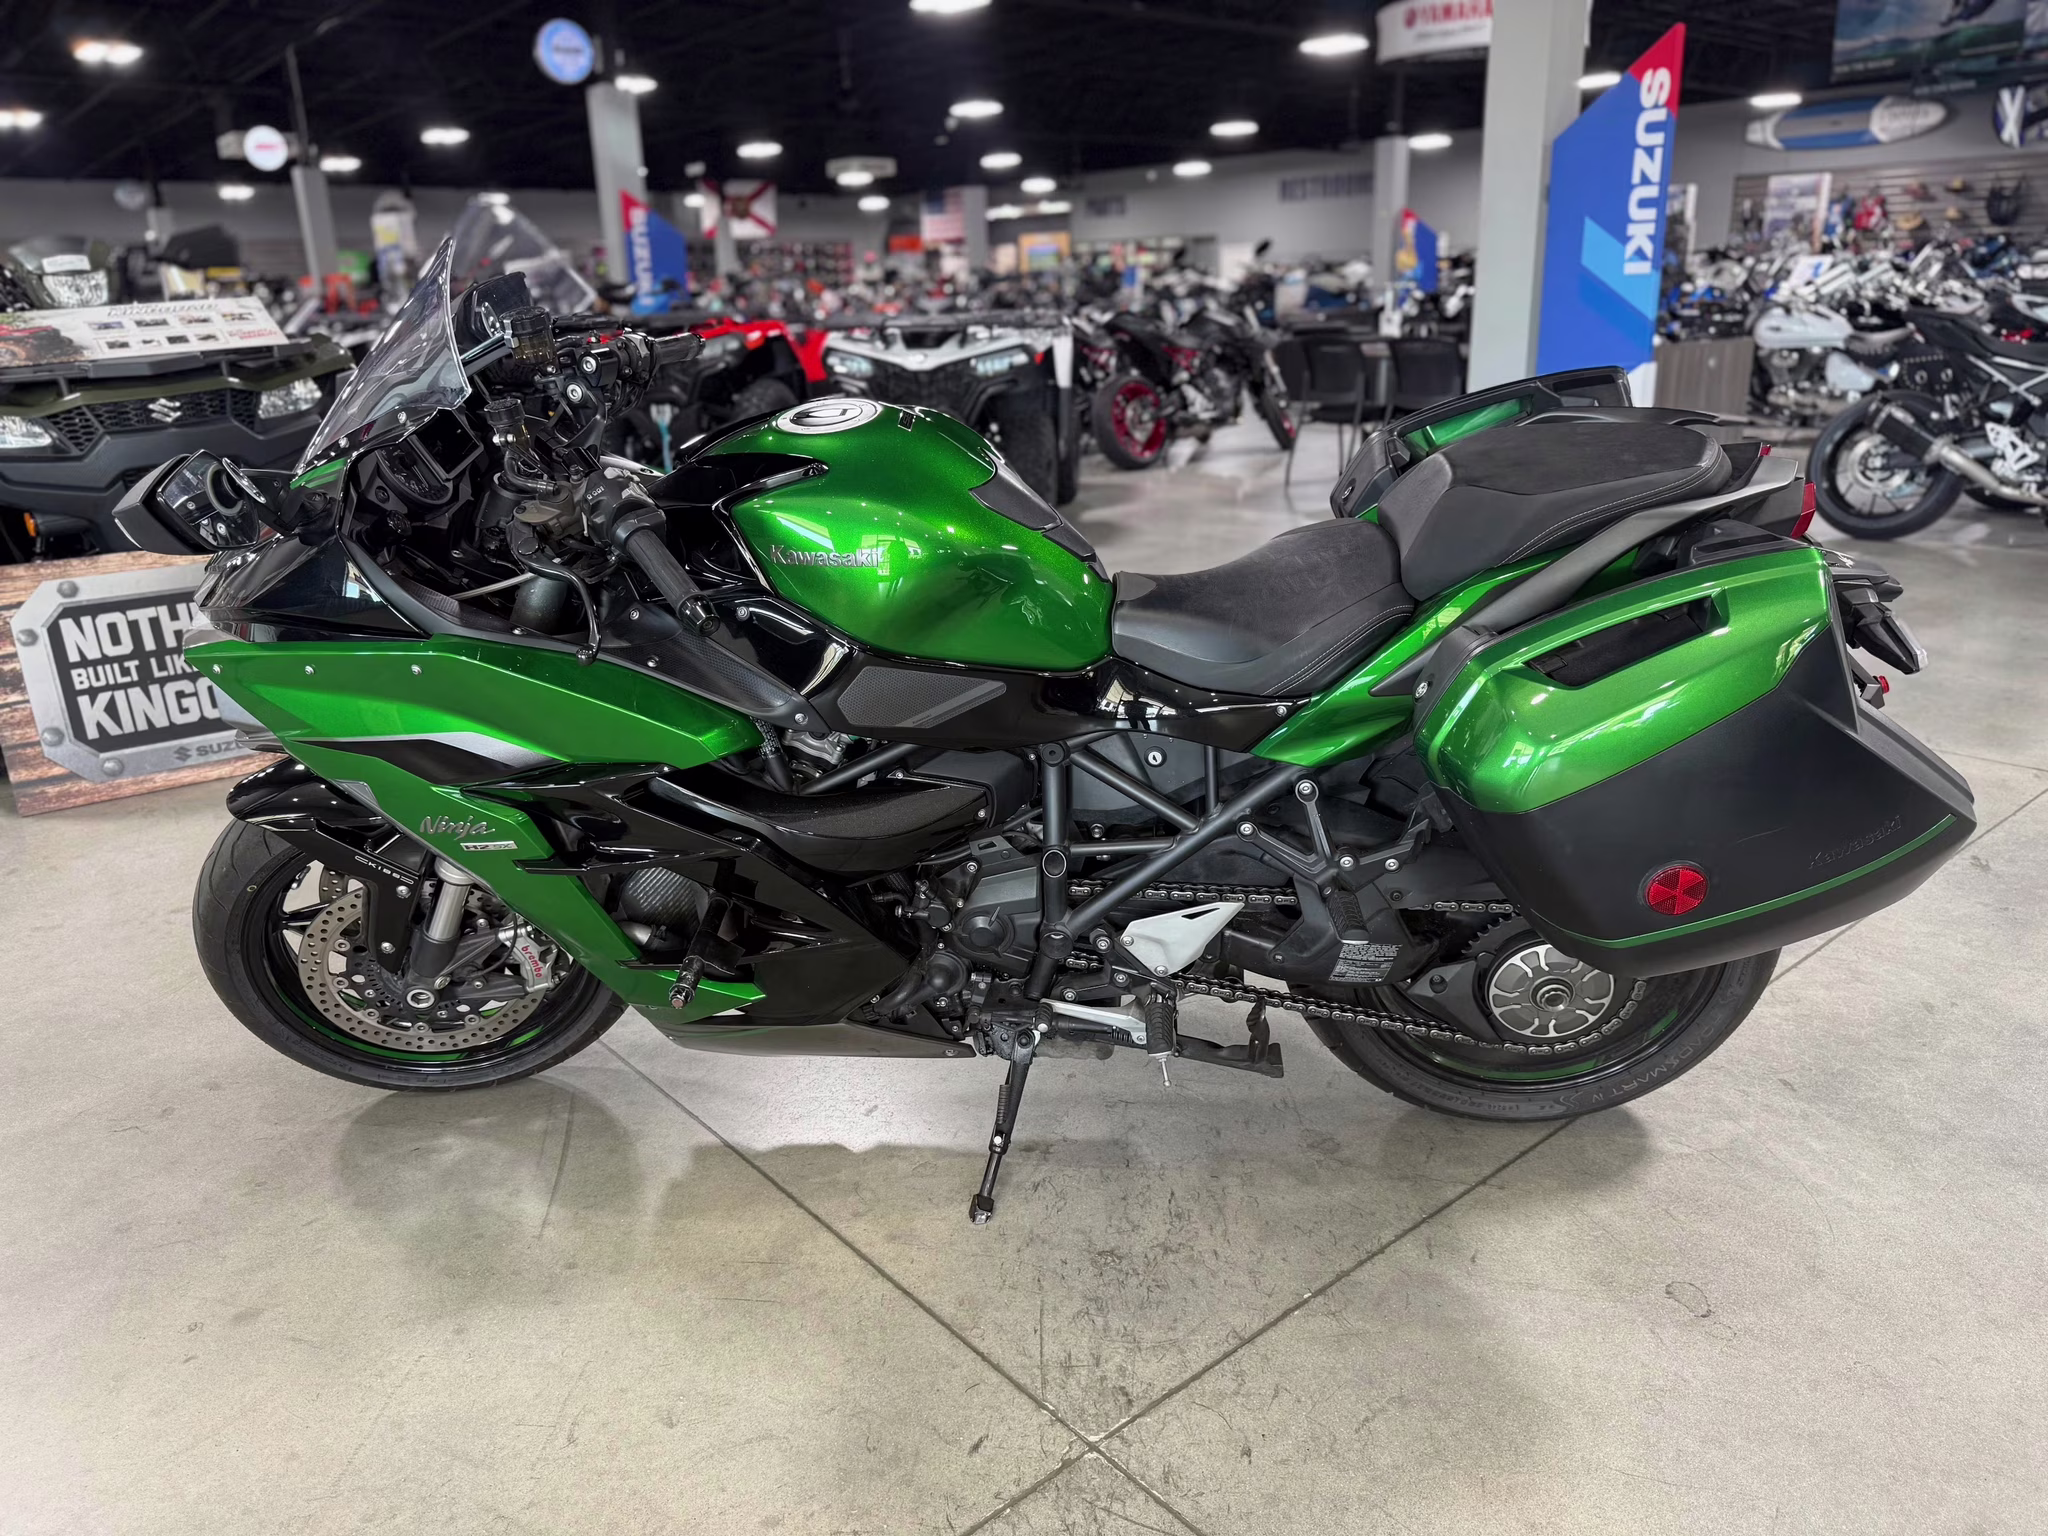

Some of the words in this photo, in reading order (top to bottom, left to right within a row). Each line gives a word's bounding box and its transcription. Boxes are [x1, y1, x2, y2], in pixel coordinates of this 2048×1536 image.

[1623, 66, 1672, 275] SUZUKI
[769, 544, 880, 568] Kawasaki
[70, 659, 140, 691] BUILT
[149, 653, 200, 679] LIK
[420, 815, 496, 841] Ninja
[1807, 815, 1902, 870] Kawasaki
[521, 944, 544, 979] brembo
